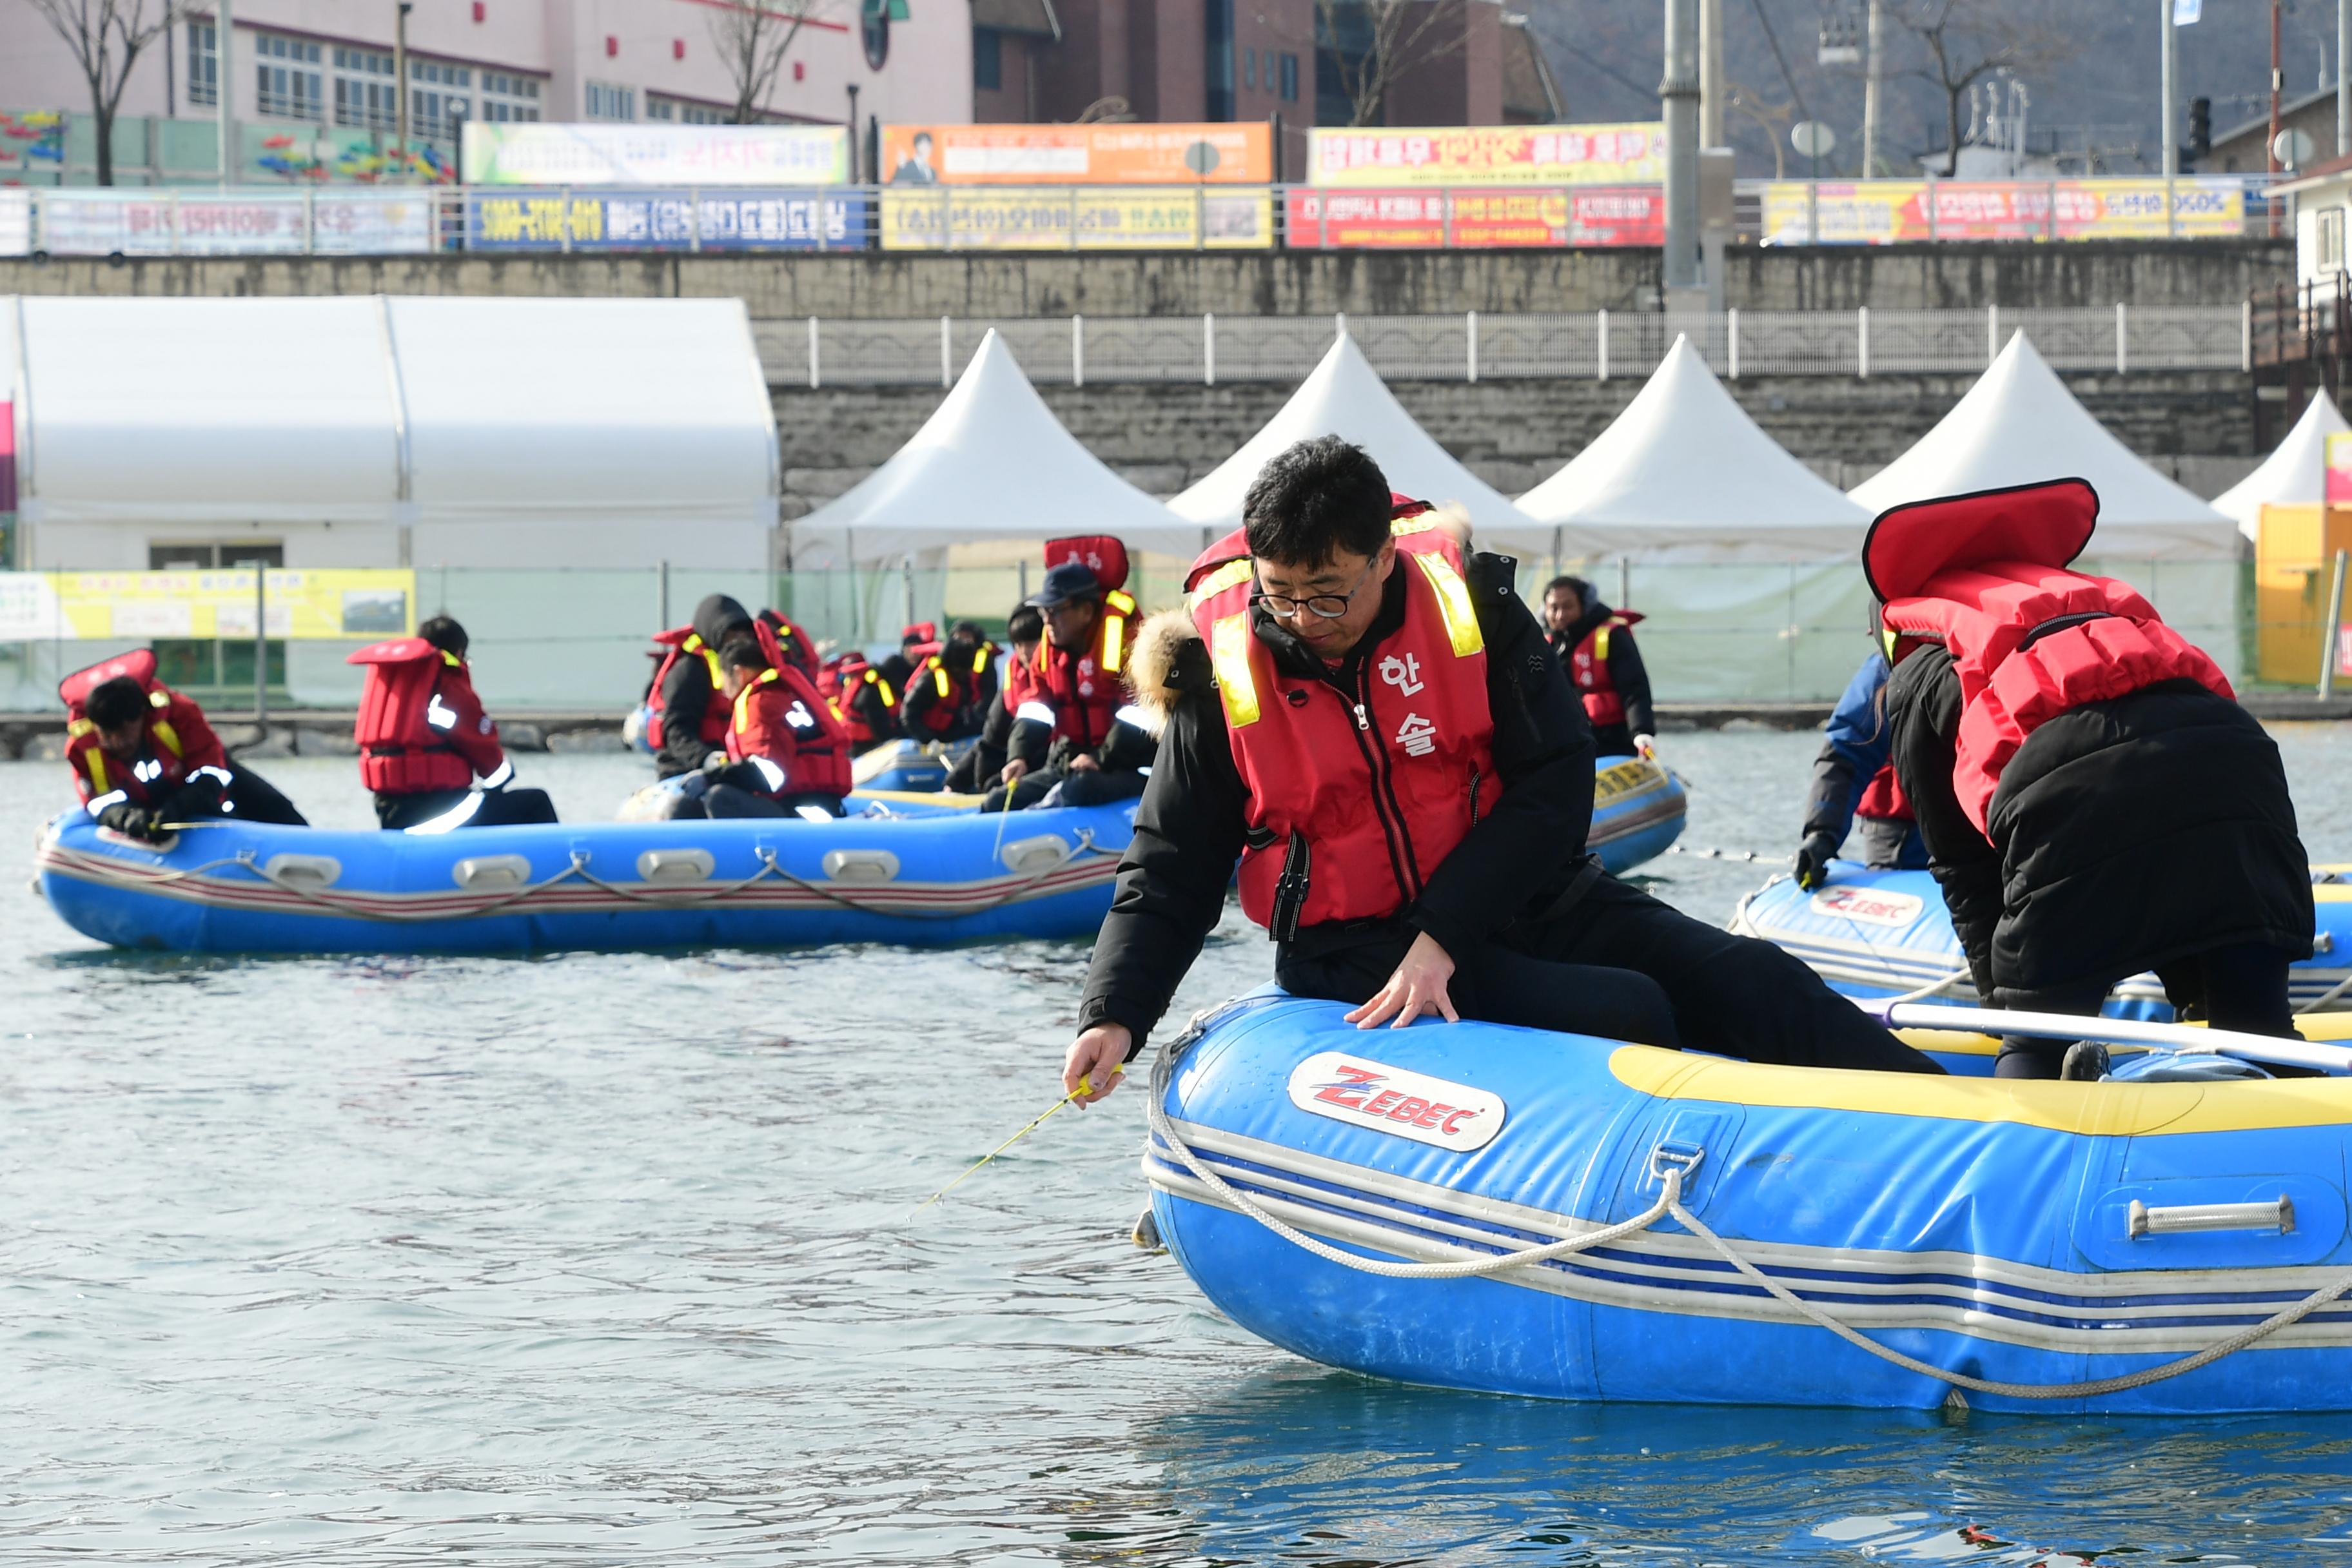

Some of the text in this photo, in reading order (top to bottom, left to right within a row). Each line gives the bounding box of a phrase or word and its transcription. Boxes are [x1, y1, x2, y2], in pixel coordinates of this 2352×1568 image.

[1378, 652, 1436, 757] 한솔
[1825, 890, 1907, 919] ZEBEC
[1309, 1065, 1480, 1135] ZEBEC
